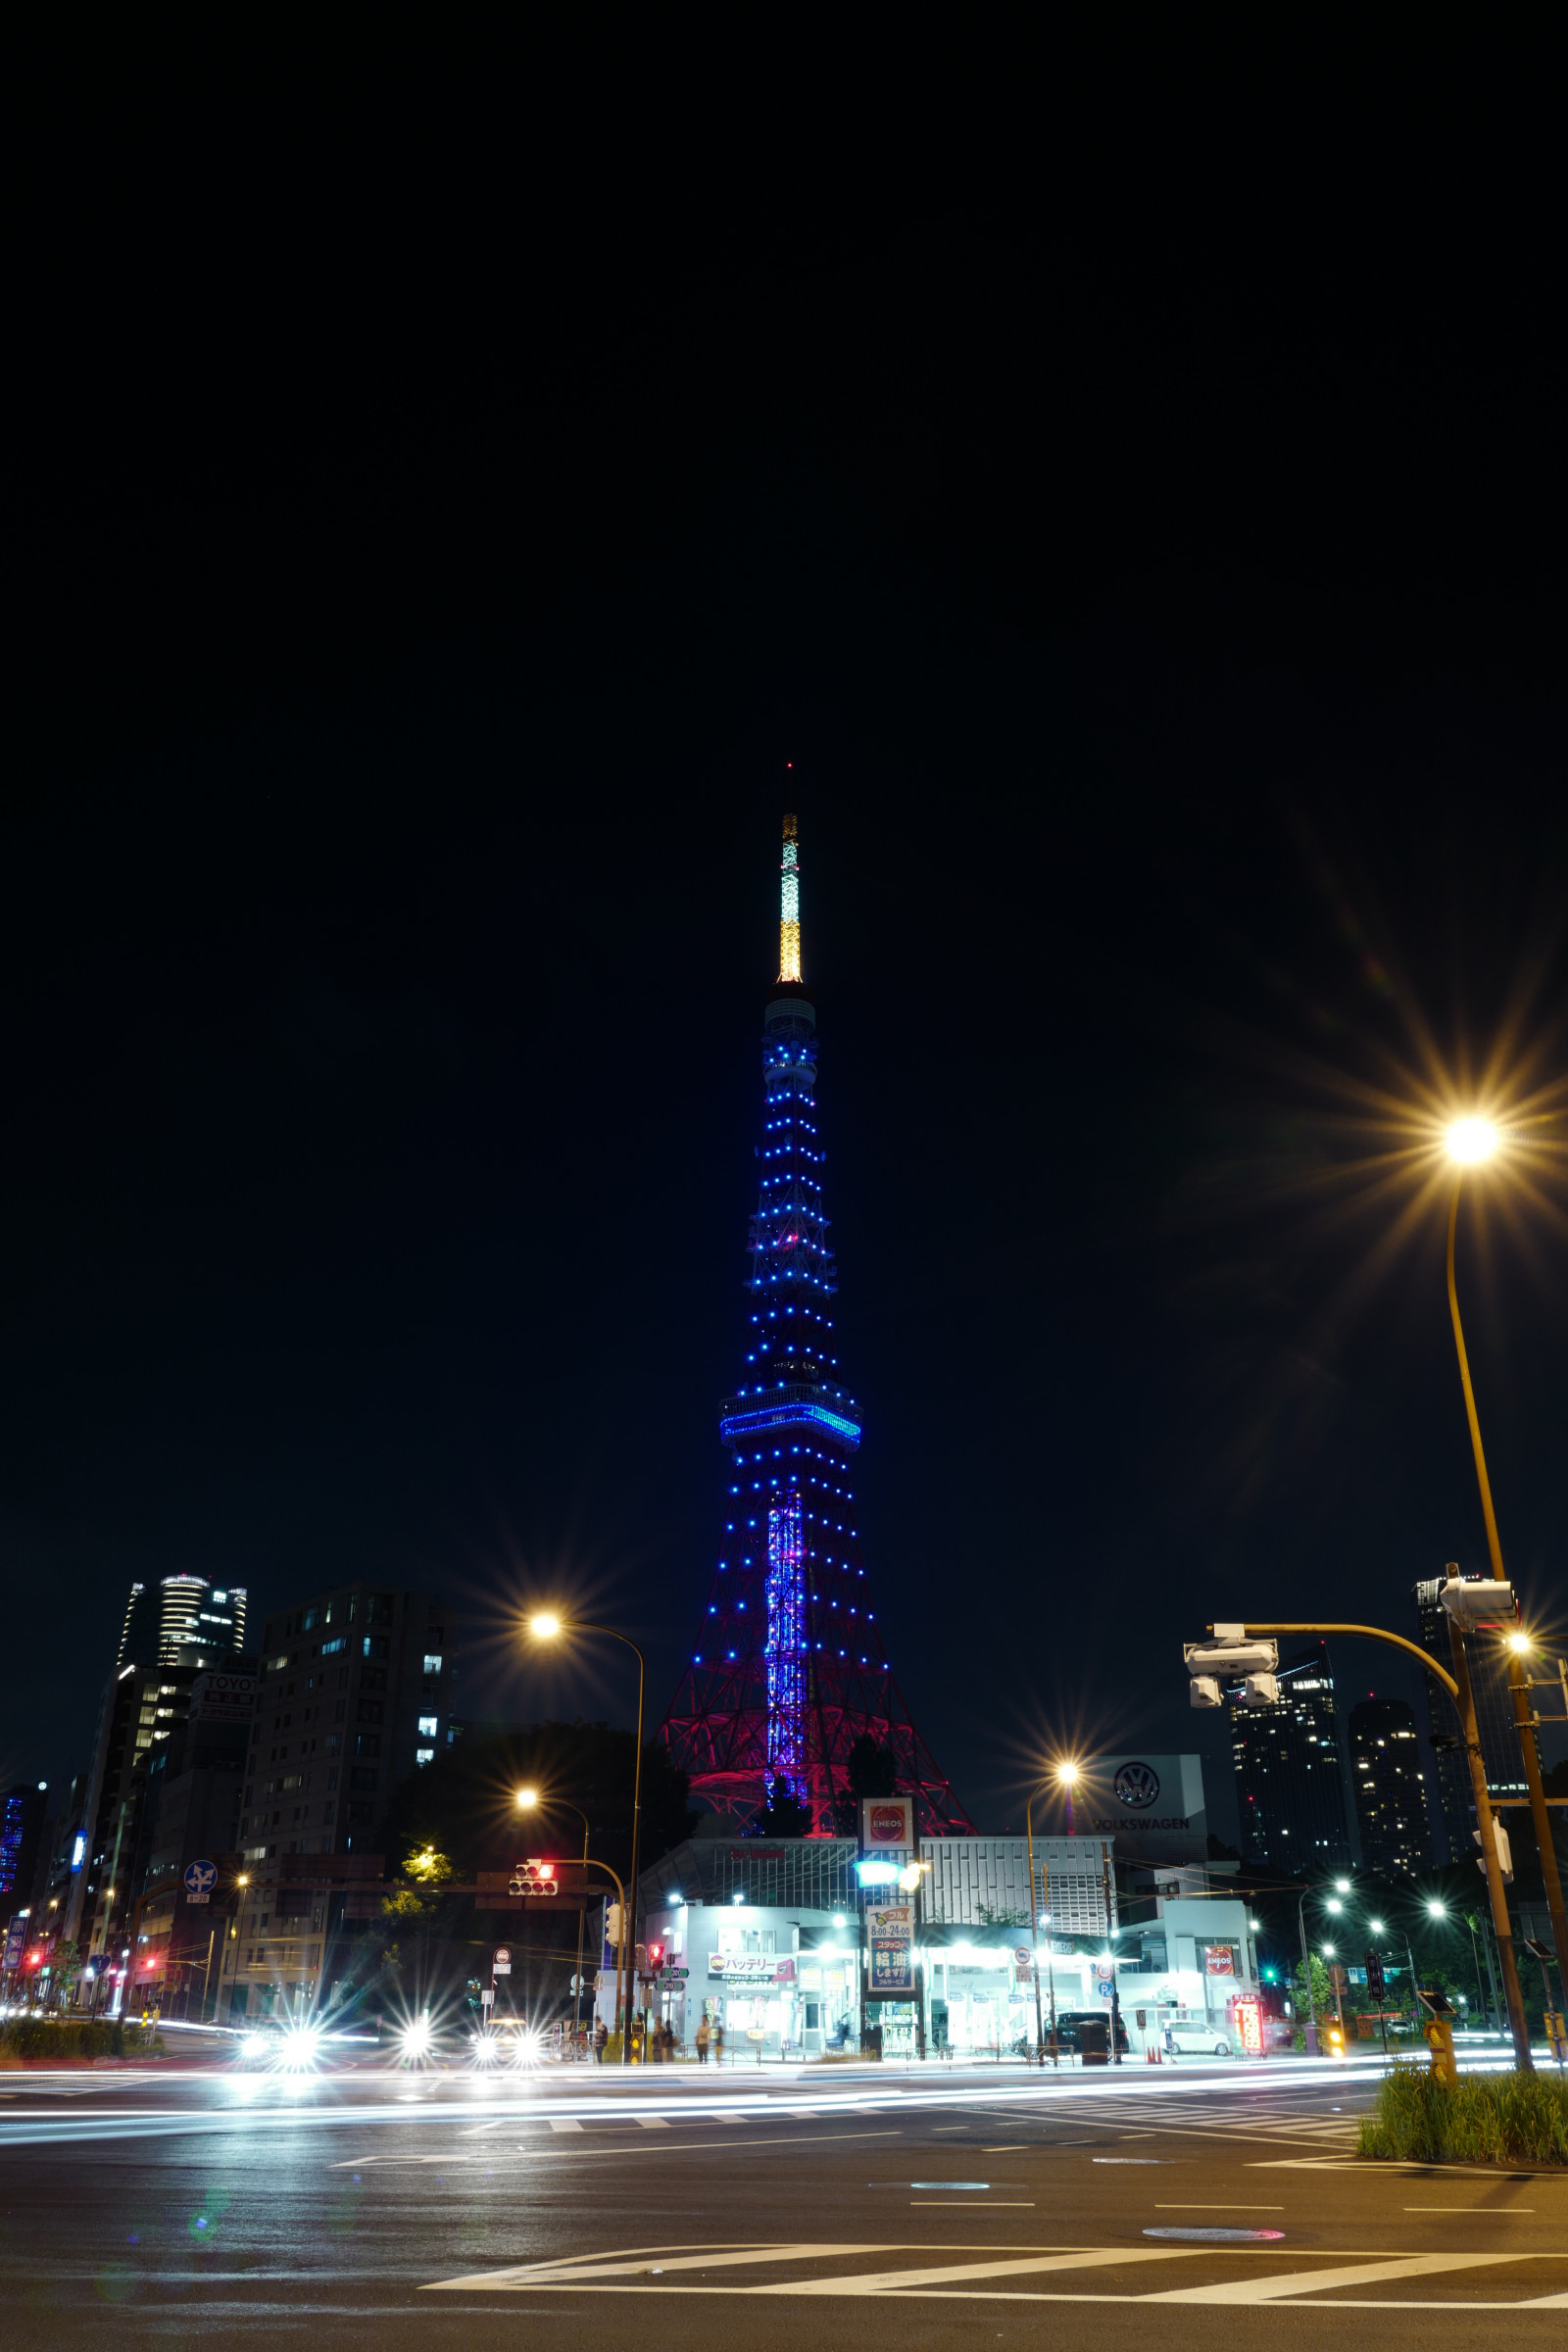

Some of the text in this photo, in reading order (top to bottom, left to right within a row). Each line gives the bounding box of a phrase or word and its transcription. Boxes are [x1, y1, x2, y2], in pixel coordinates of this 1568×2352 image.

[1093, 1819, 1190, 1831] VOLKSWAGEN
[8, 1920, 24, 1965] 赤羽橋
[726, 1958, 775, 1971] バッテリー
[875, 1951, 906, 1967] 給油
